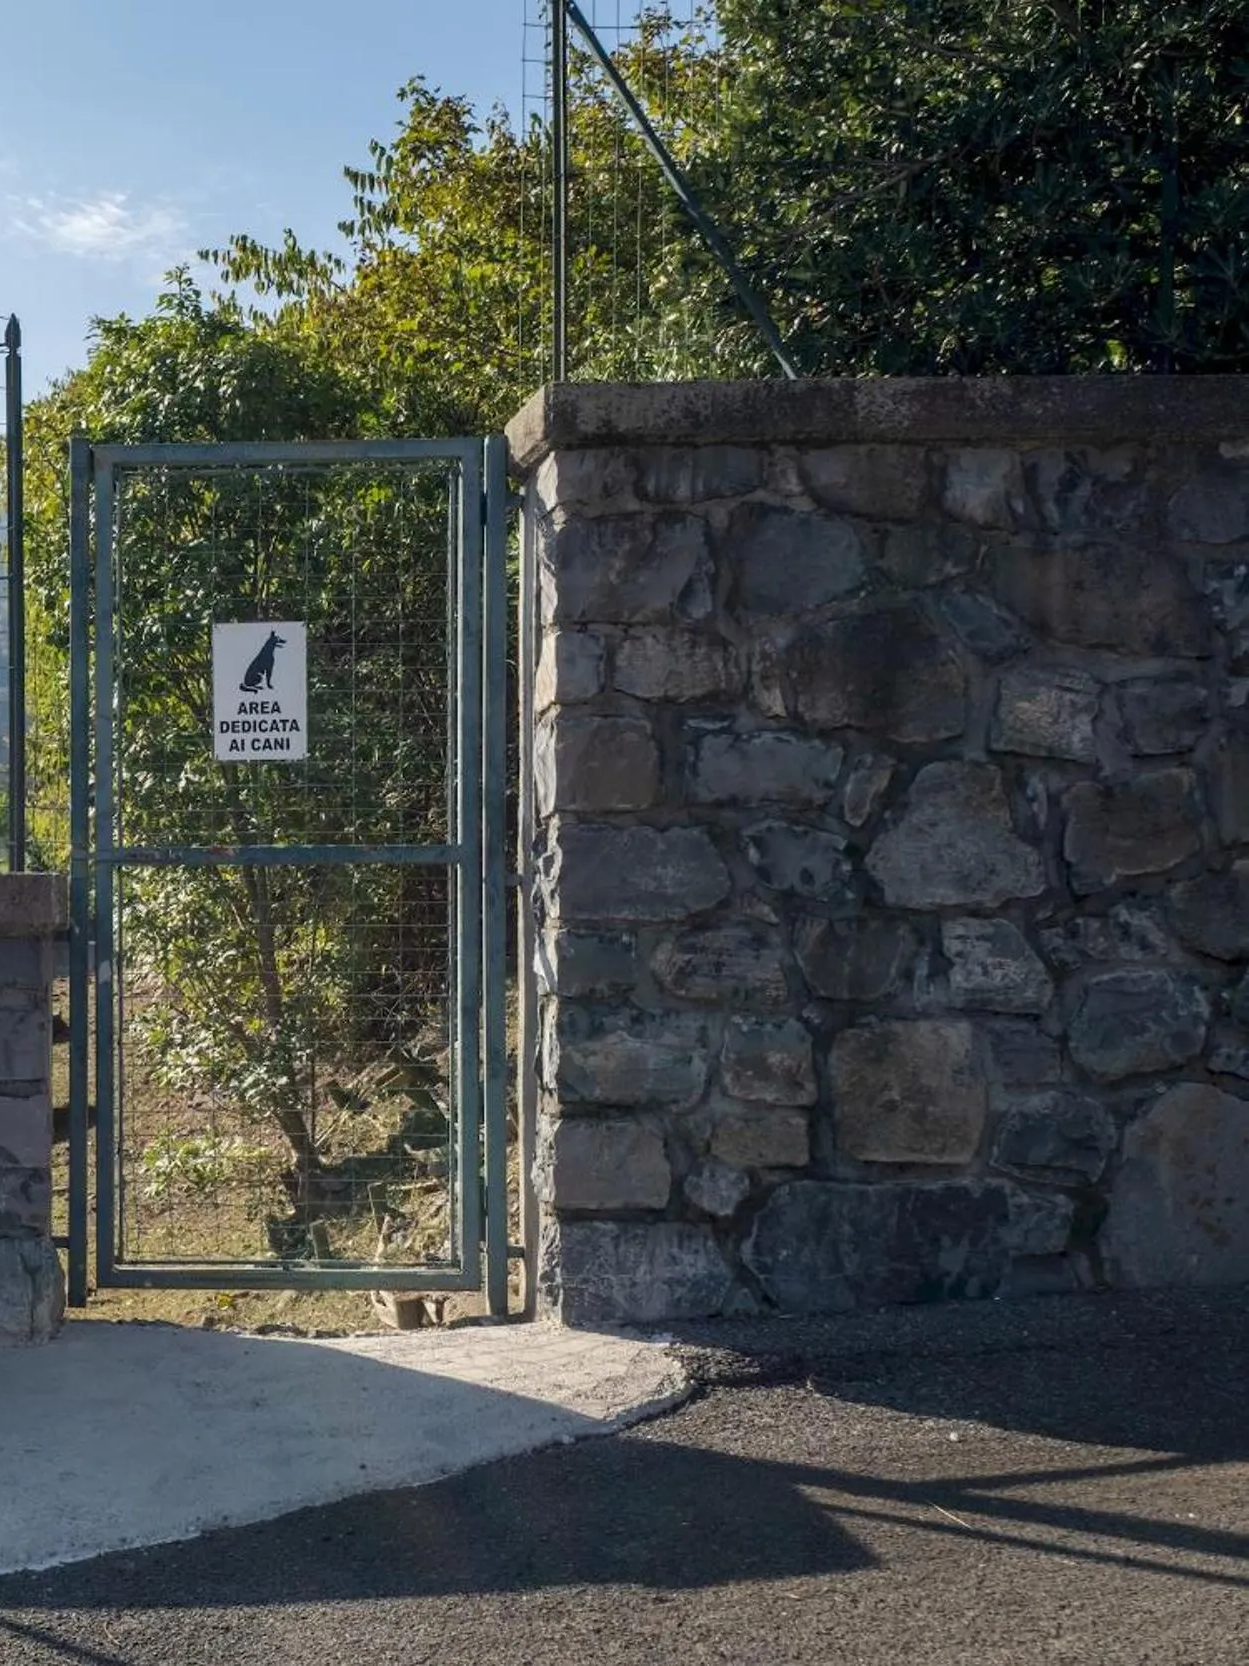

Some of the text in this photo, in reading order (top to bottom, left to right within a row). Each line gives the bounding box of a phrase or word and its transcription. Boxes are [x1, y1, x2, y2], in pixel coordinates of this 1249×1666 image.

[237, 701, 282, 715] AREA
[219, 719, 300, 734] DEDICATA
[229, 737, 290, 752] AI CANI
